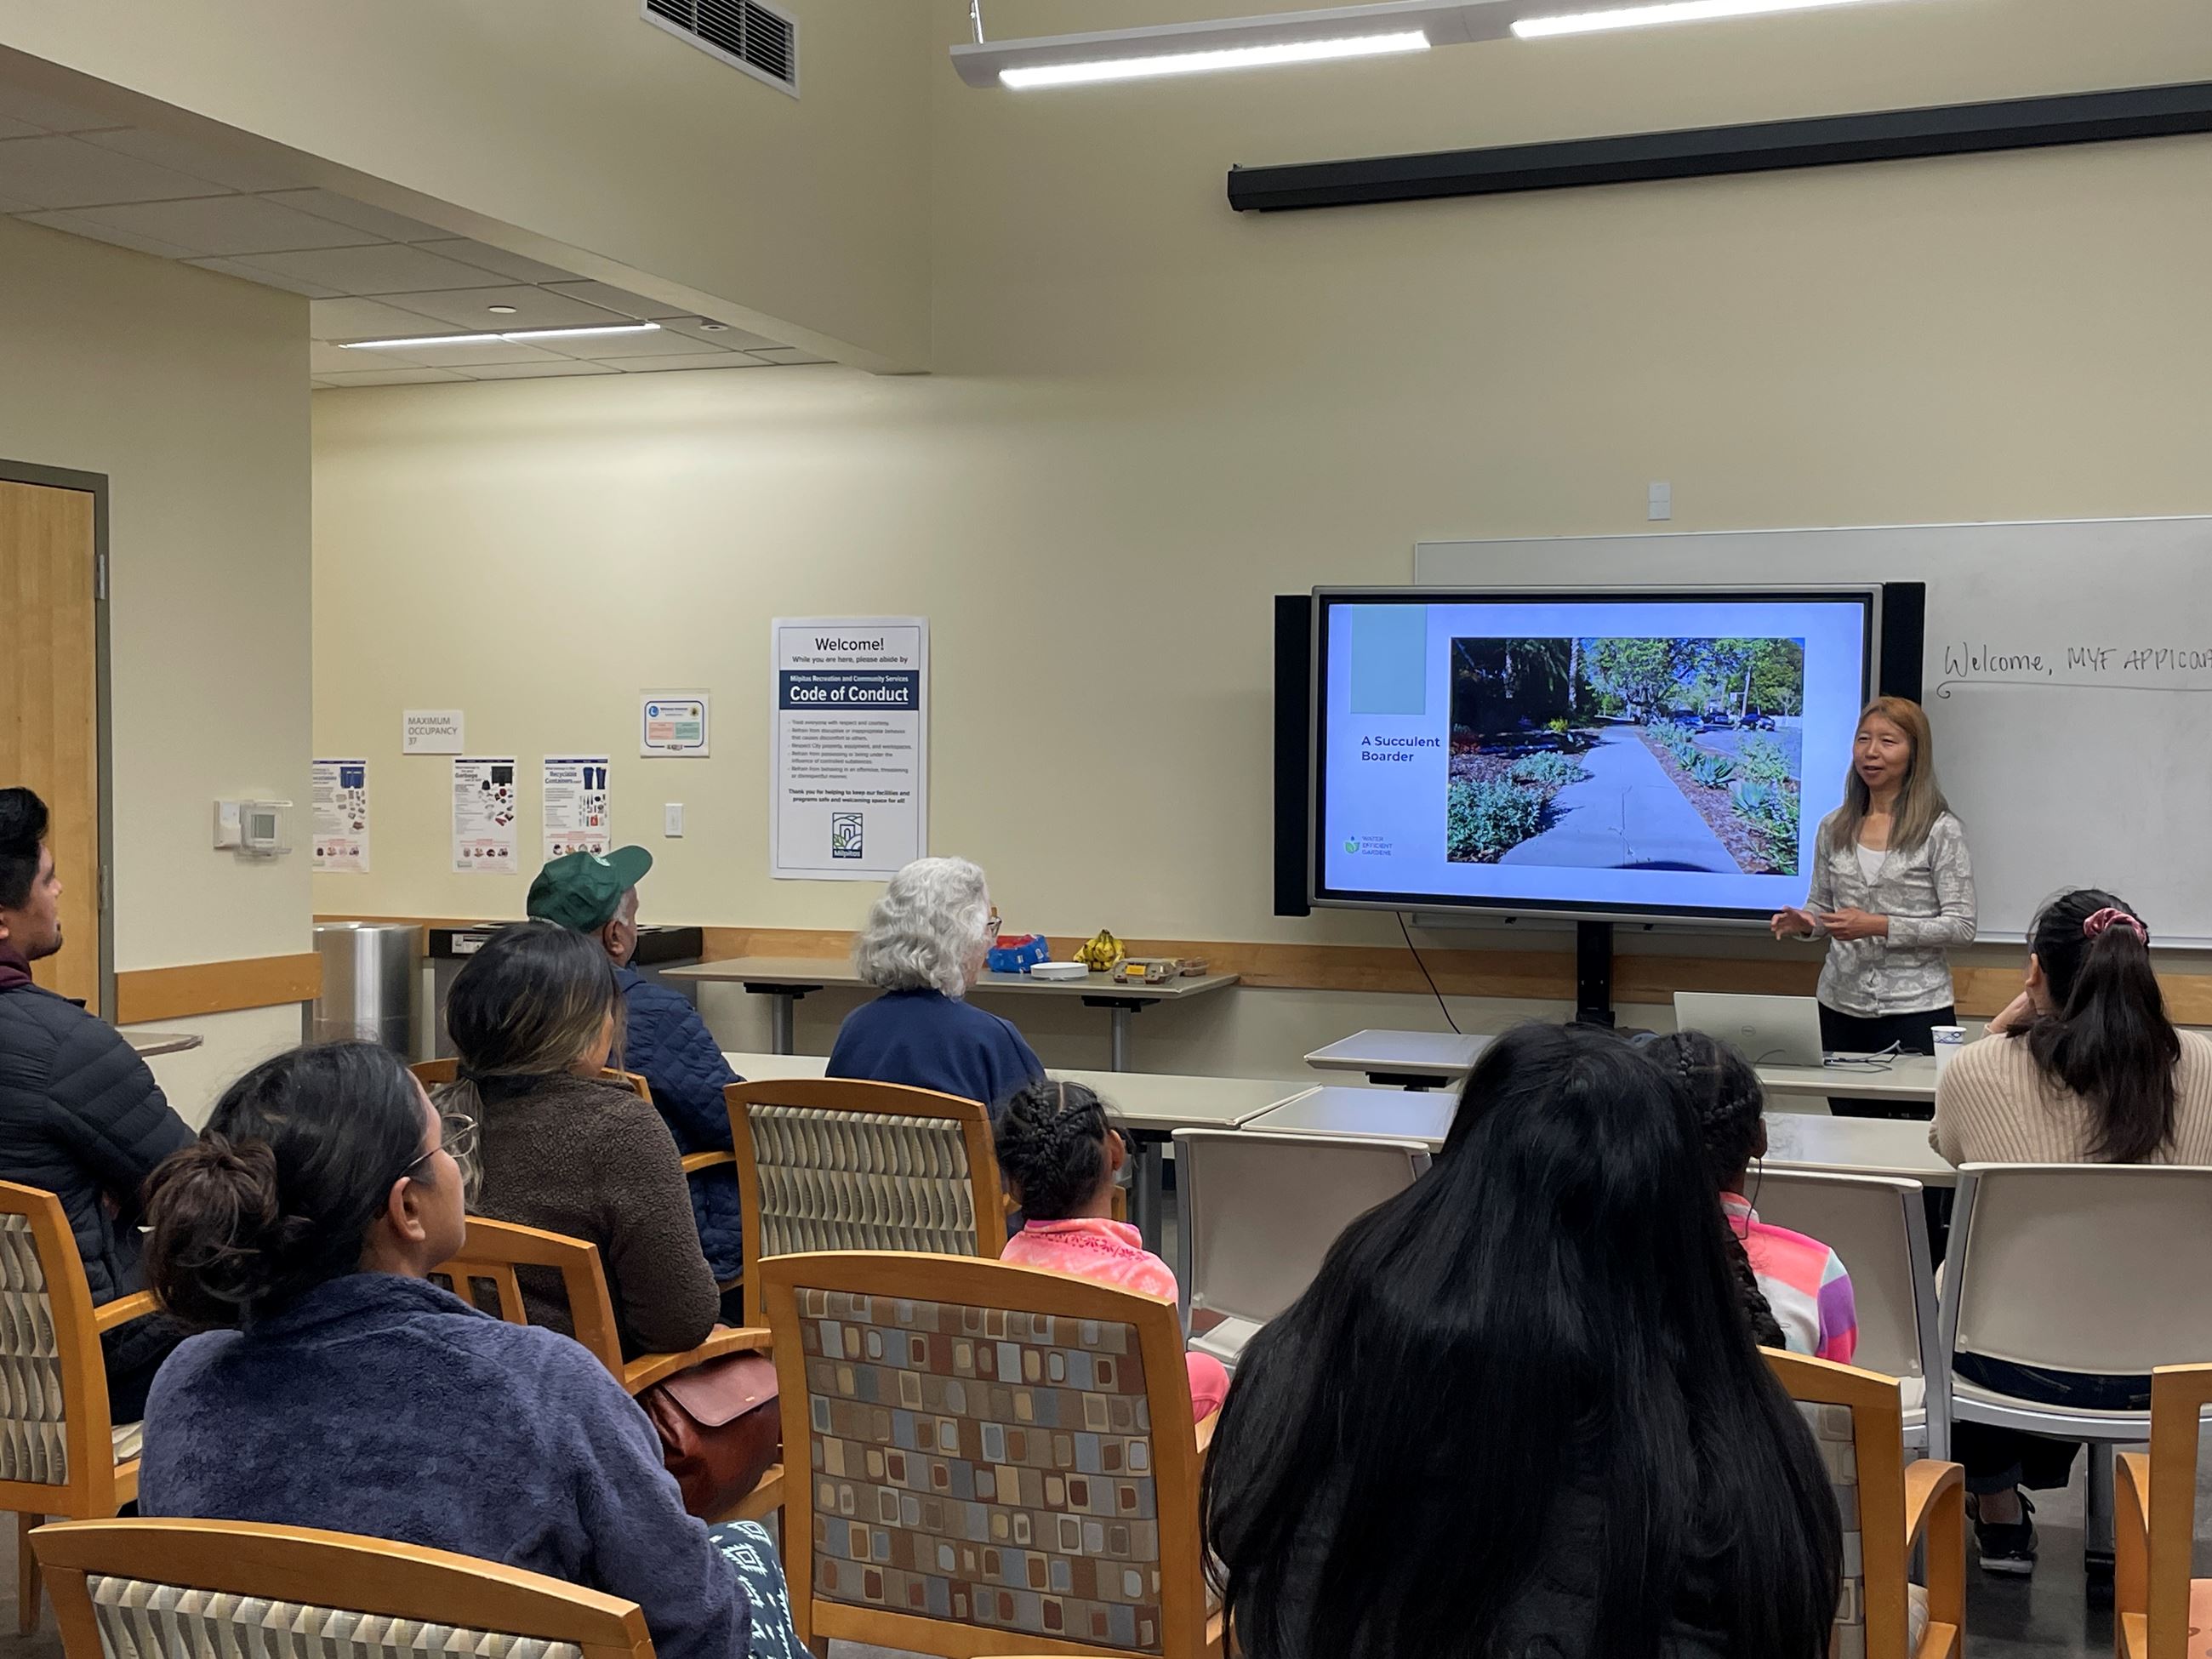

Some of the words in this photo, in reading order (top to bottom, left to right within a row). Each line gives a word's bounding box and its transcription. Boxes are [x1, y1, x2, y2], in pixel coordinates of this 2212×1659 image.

[815, 637, 885, 651] Welcome!
[856, 656, 878, 664] please
[899, 656, 909, 664] by
[1944, 641, 2052, 677] Welcome,
[2067, 647, 2117, 671] MYF
[790, 675, 812, 683] Milpitas
[853, 675, 885, 684] Community
[885, 675, 909, 683] Services
[790, 686, 827, 702] Code
[830, 686, 846, 702] of
[848, 686, 909, 702] Conduct
[408, 716, 451, 725] MAXIMUM
[408, 727, 458, 735] OCCUPANCY
[408, 737, 417, 745] 37
[1361, 736, 1371, 746] A
[1374, 736, 1440, 748] Succulent
[1361, 751, 1414, 761] Boarder
